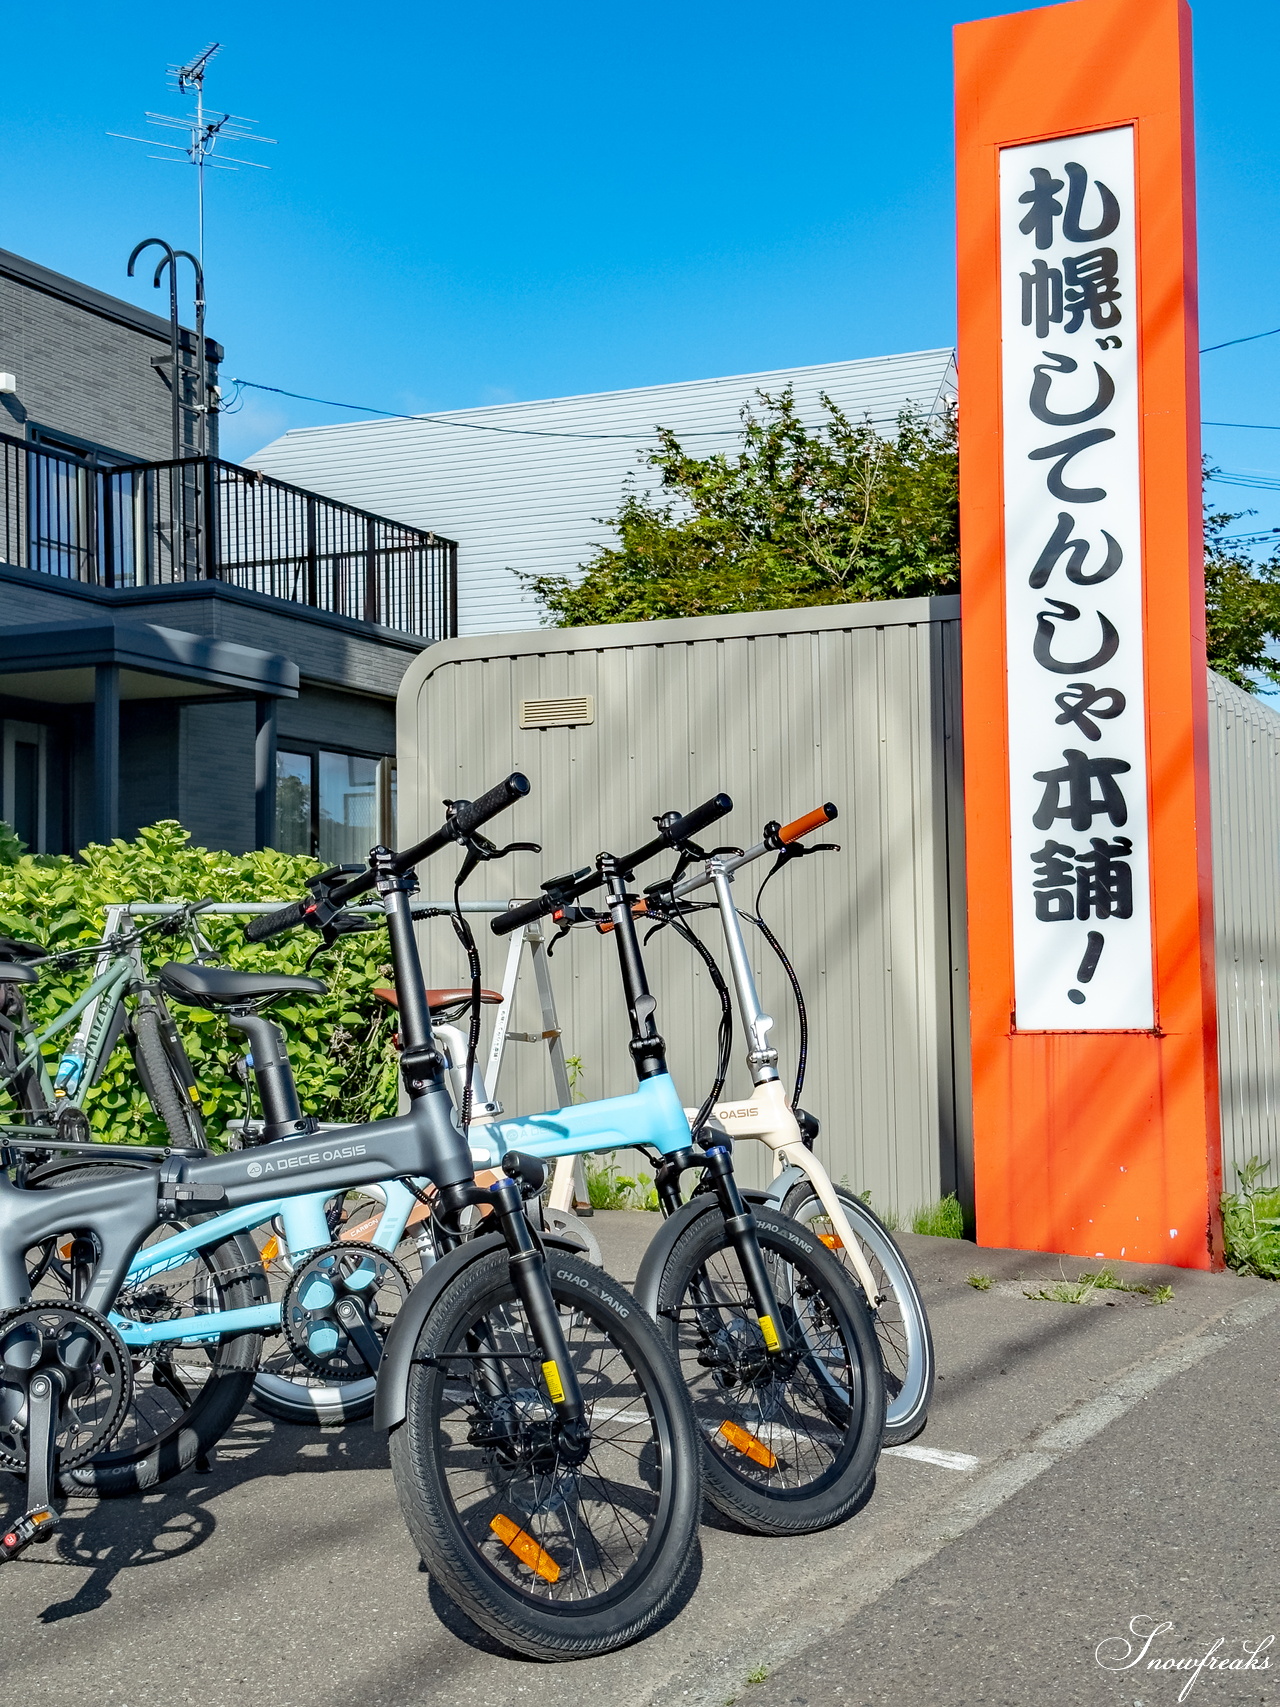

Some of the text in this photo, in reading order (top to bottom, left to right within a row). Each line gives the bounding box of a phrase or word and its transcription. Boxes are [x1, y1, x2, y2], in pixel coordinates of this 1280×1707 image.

[719, 1107, 759, 1120] OASIS
[264, 1162, 275, 1173] A
[277, 1153, 320, 1170] DECE
[322, 1144, 367, 1161] OASIS
[350, 1218, 379, 1237] CARBON
[787, 1232, 814, 1254] YANG
[556, 1269, 630, 1319] CHAO YANG
[72, 1460, 148, 1477] CHAO YAN
